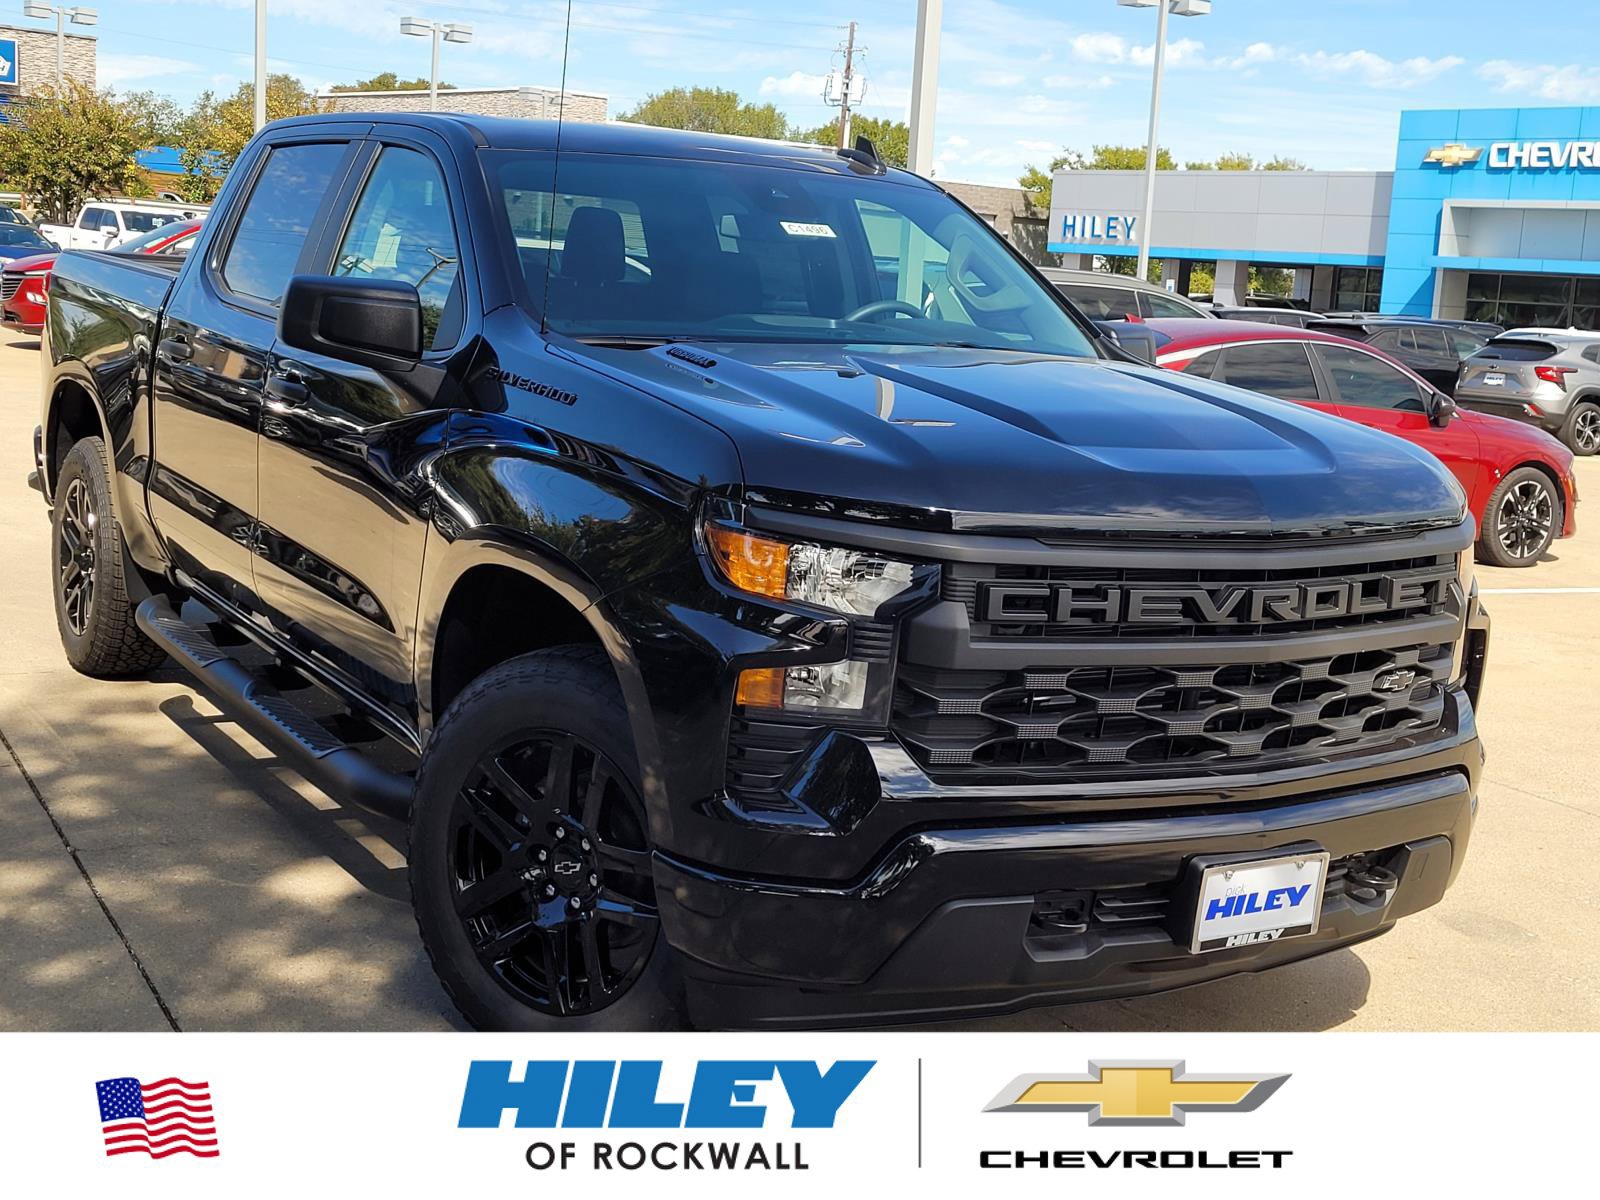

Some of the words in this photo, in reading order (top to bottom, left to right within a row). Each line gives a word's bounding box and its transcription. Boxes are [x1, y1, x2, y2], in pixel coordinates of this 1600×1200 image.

[1062, 215, 1136, 240] HILEY
[1205, 884, 1312, 921] HILEY
[1225, 929, 1285, 947] HILEY
